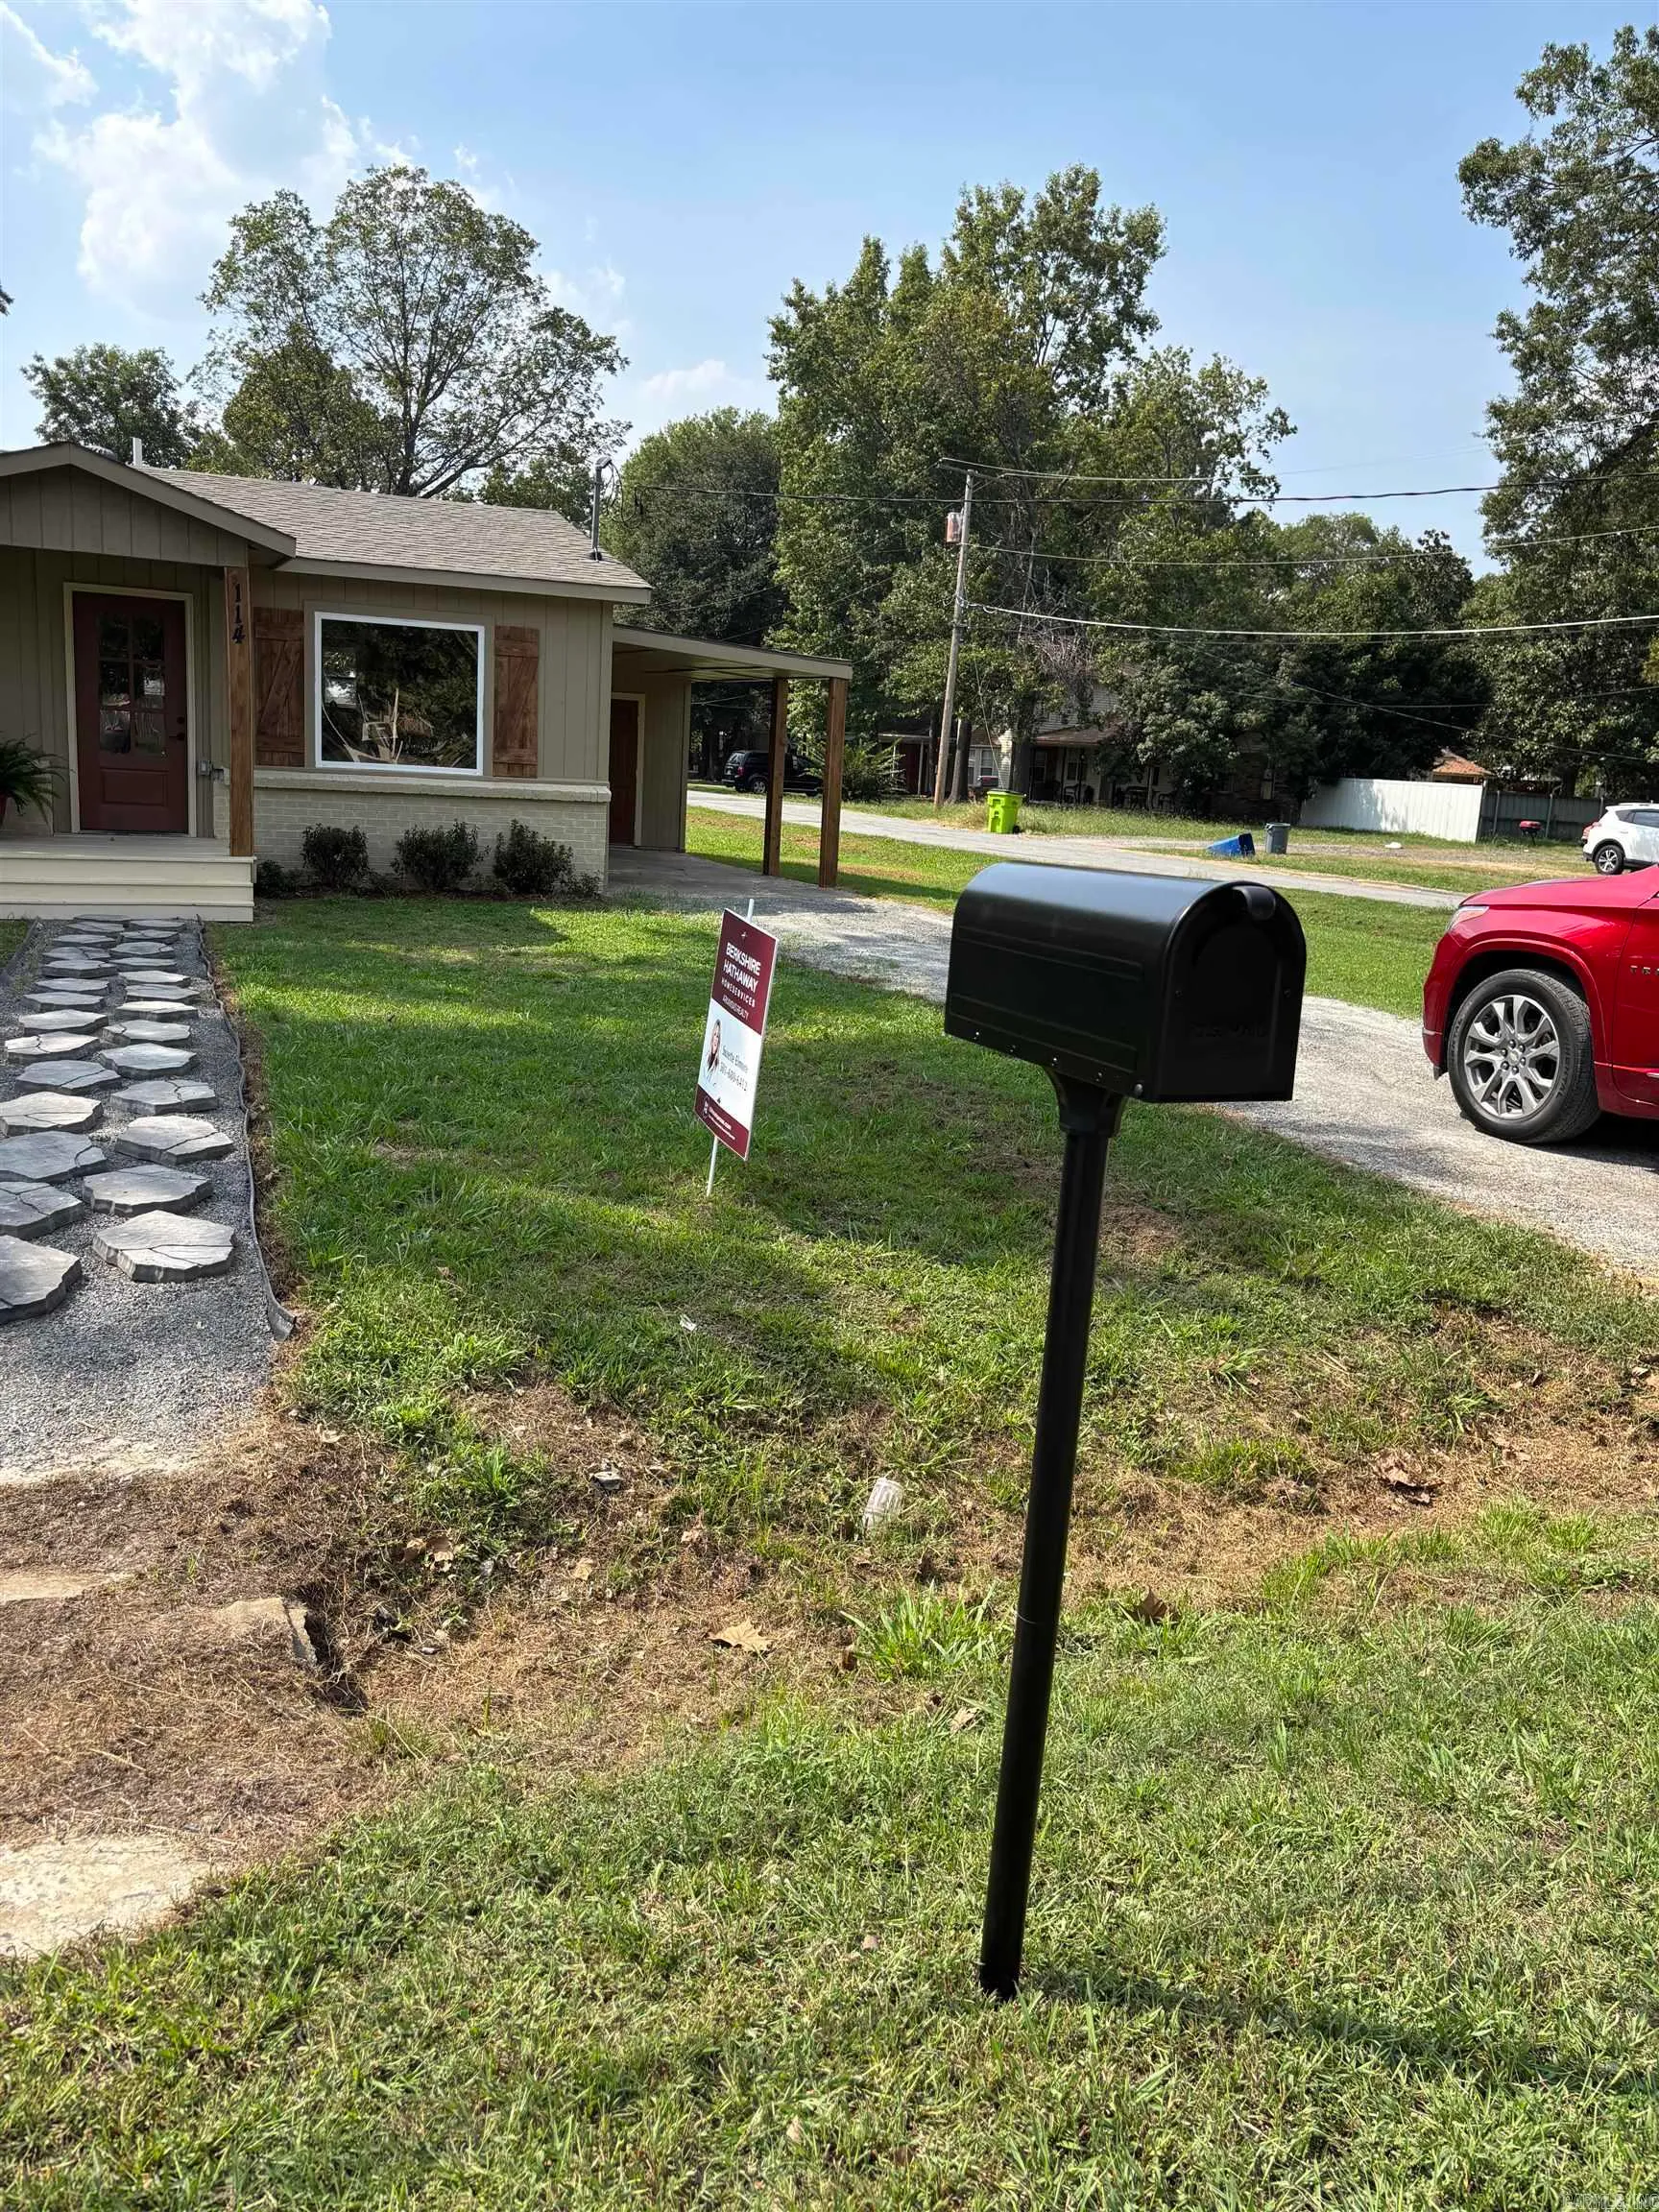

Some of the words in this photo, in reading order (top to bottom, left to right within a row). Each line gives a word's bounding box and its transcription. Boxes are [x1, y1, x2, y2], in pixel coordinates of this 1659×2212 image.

[231, 583, 246, 644] 114
[723, 959, 758, 993] HATHAWAY
[726, 942, 761, 976] BERKSHIRE
